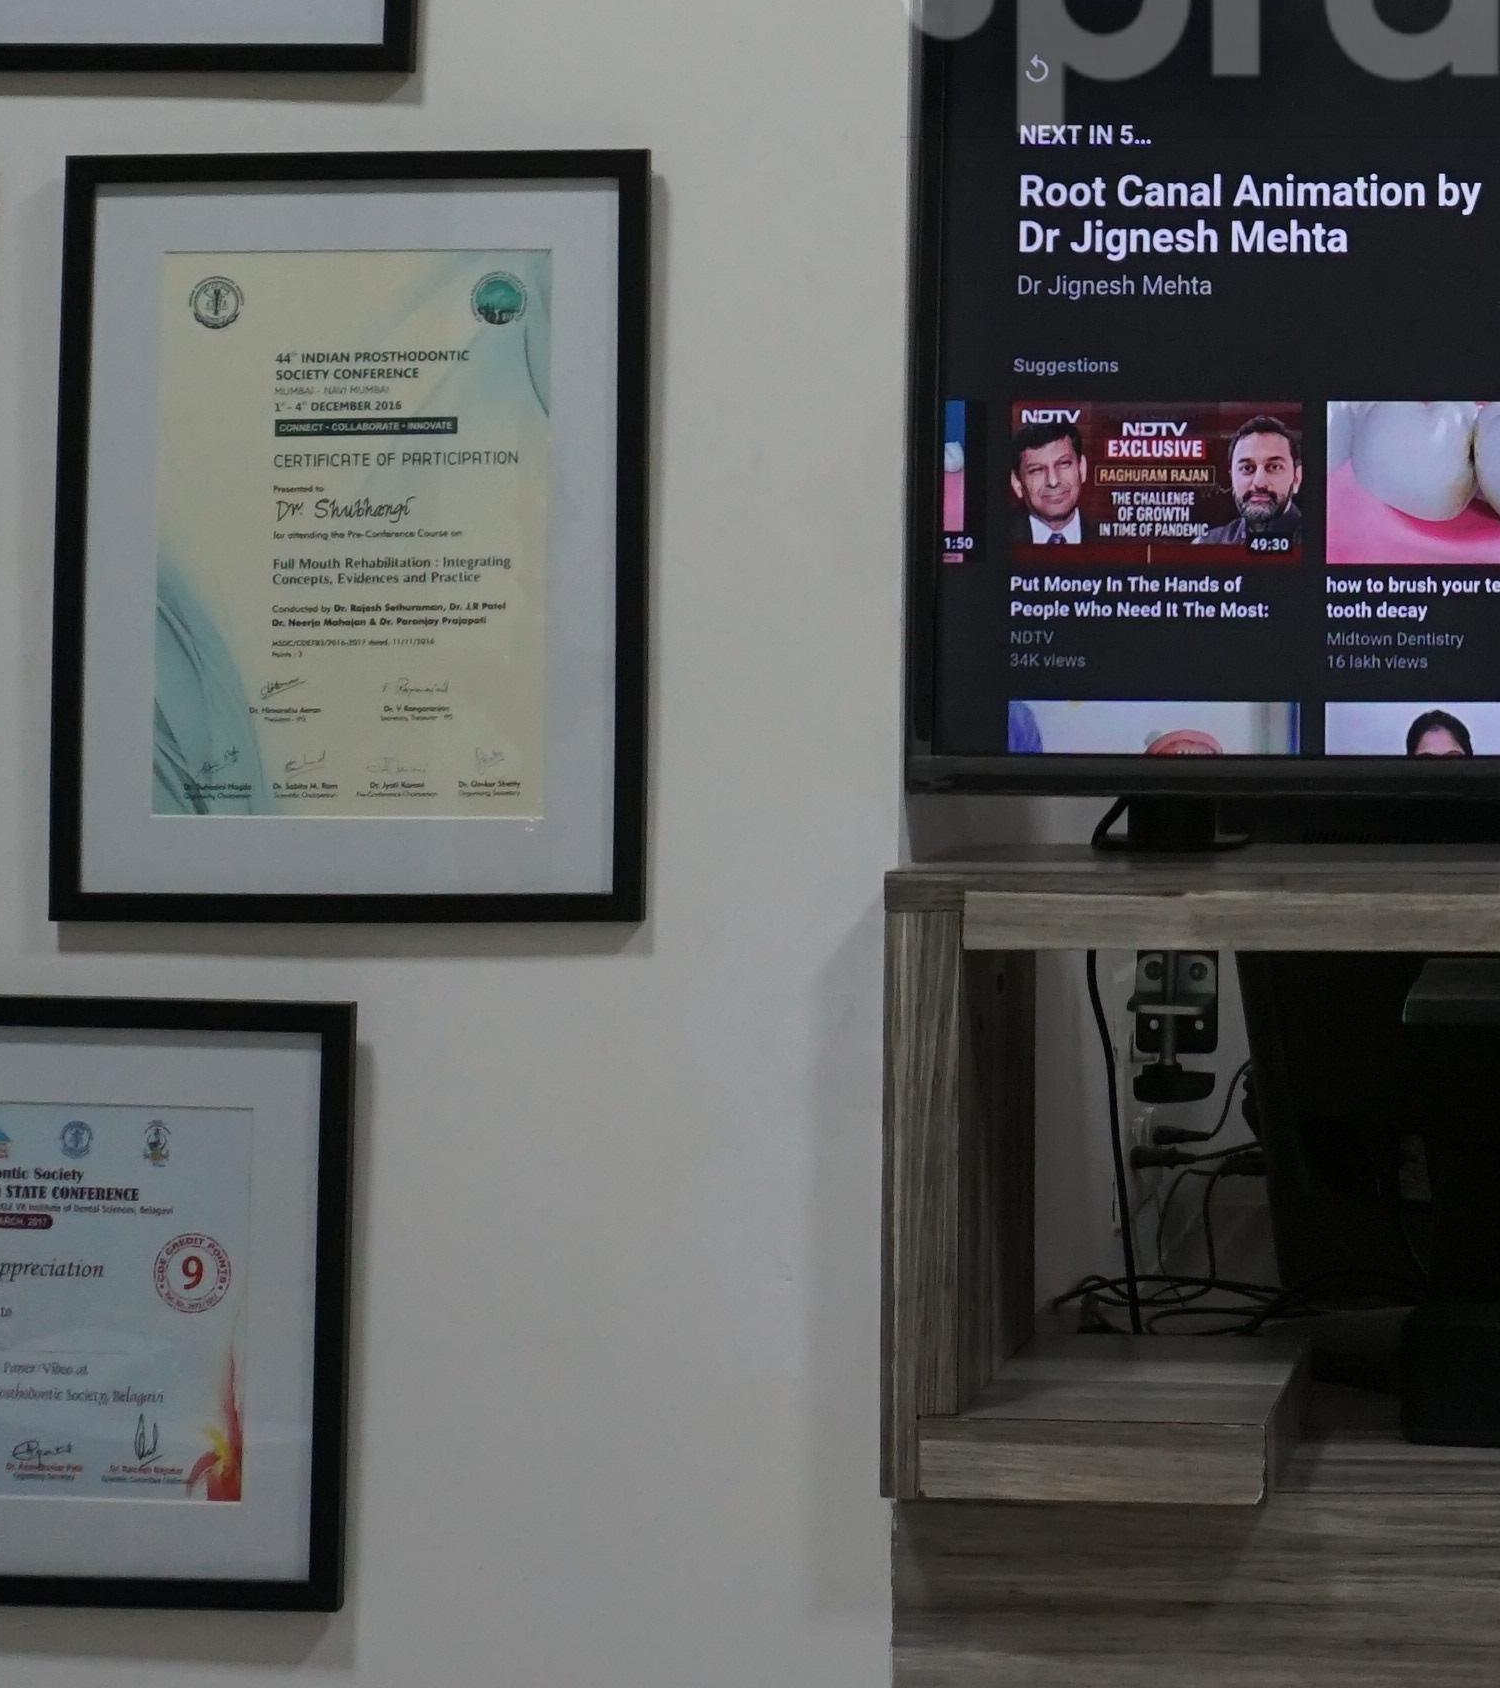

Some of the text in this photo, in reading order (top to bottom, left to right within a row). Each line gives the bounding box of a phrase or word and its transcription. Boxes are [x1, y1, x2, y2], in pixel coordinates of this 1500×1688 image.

[1019, 123, 1152, 145] NEXT IN 5...
[1019, 172, 1483, 216] Root Canal Animation by
[1018, 218, 1349, 262] Dr Jignesh Mehta
[1017, 274, 1212, 301] Dr Jignesh Mehta
[301, 349, 470, 364] INDIAN PROSTHODONTIC
[275, 367, 419, 381] SOCIETY CONFERENCE
[1013, 357, 1119, 377] Suggestions
[1021, 409, 1081, 424] NDTV
[278, 421, 453, 433] CONNECT COLLABORATE INNOVATE
[1122, 422, 1188, 437] NDTV
[1107, 439, 1203, 458] EXCLUSIVE
[273, 450, 519, 469] CERTIFICATE OF PARTICIPATION
[1099, 468, 1209, 482] RAGHURAM RAJAN
[1110, 491, 1195, 506] THE CHALLENGE
[1117, 506, 1190, 522] OF GROWTH
[1099, 523, 1209, 537] IN TIME OF PANDEMIC
[943, 536, 974, 550] 1:50
[1250, 538, 1289, 551] 49:30
[1010, 575, 1243, 596] Put Money In The Hands of
[1326, 575, 1363, 594] how
[1366, 577, 1384, 593] to
[1388, 575, 1438, 594] brush
[1441, 580, 1481, 597] your
[1010, 599, 1269, 621] People Who Need It The Most:
[1326, 600, 1428, 622] tooth decay
[1010, 630, 1055, 645] NDTV
[1326, 631, 1465, 650] Midtown Dentistry
[33, 1167, 85, 1185] Society
[181, 1255, 204, 1290] 9
